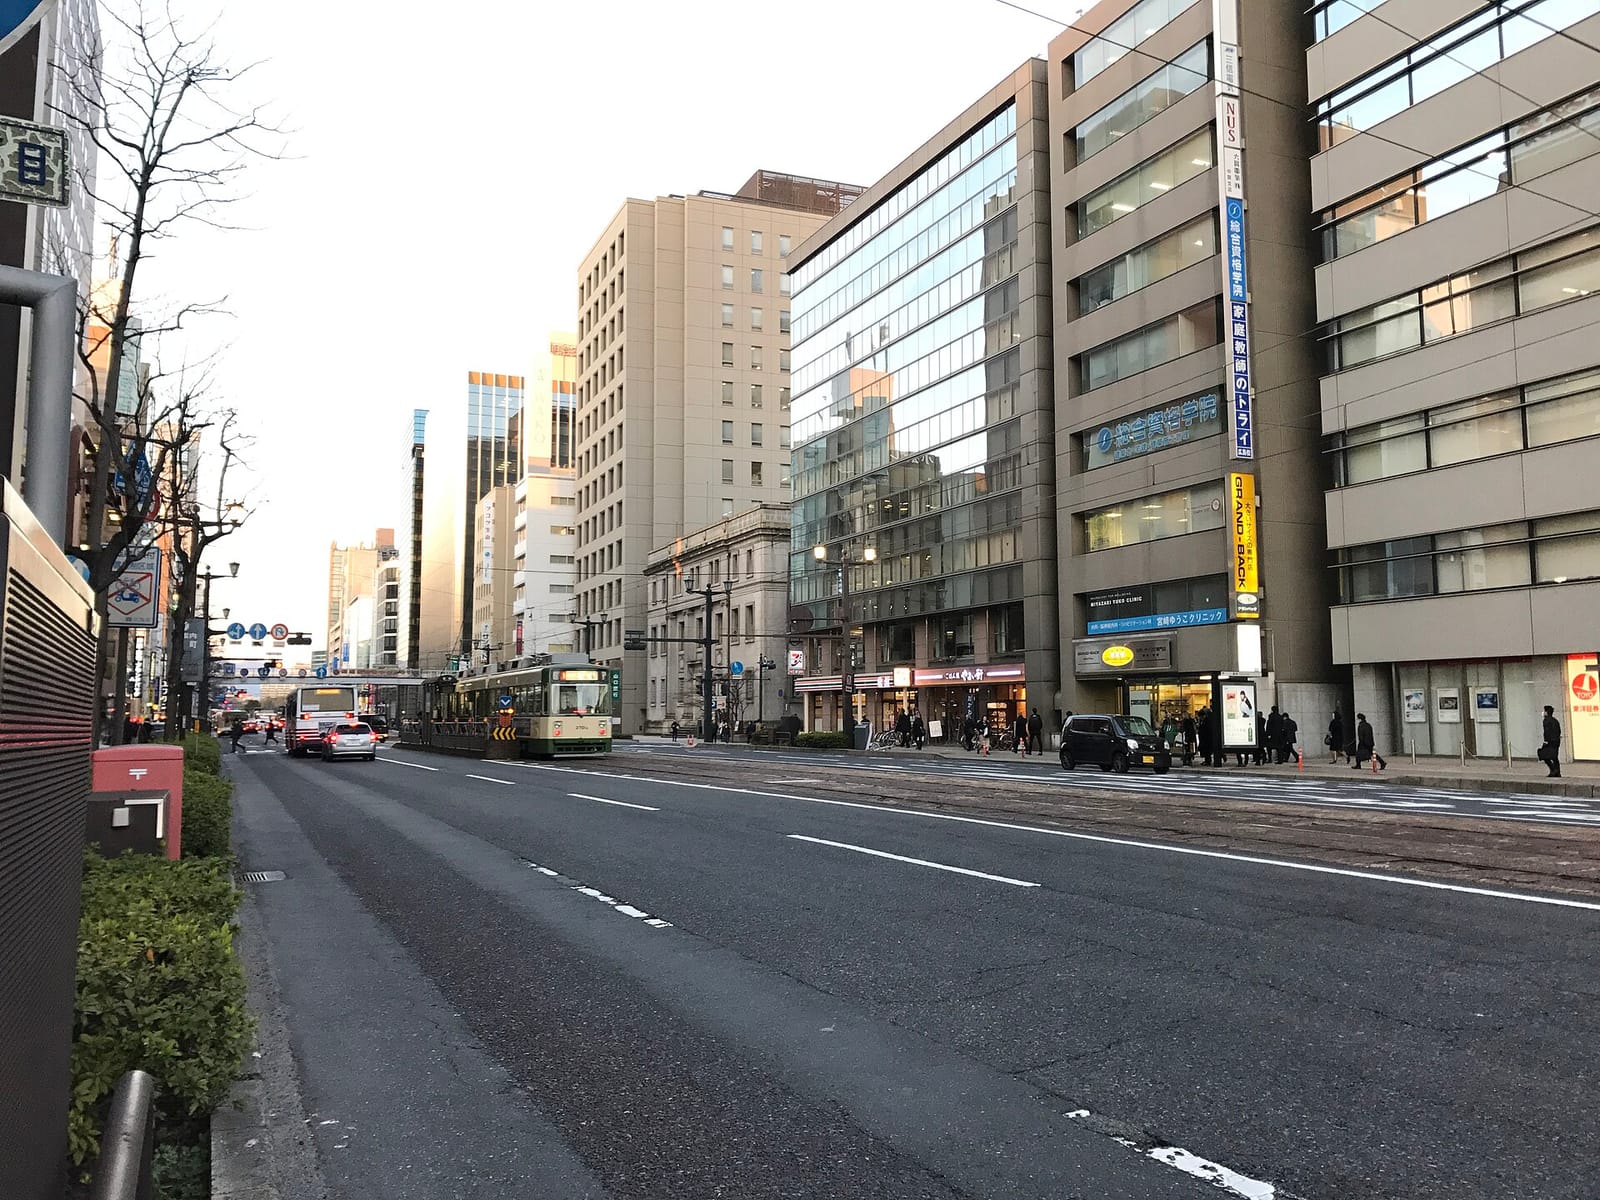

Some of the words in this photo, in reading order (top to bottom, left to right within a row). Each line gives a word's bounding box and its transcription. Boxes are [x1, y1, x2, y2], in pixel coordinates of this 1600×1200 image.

[1226, 102, 1236, 142] NUS
[1230, 220, 1243, 297] 総合資格学院
[1233, 305, 1249, 446] 家庭教師のトライ
[1113, 393, 1217, 448] 総合資格学院
[1235, 476, 1246, 588] GRAND-BACK
